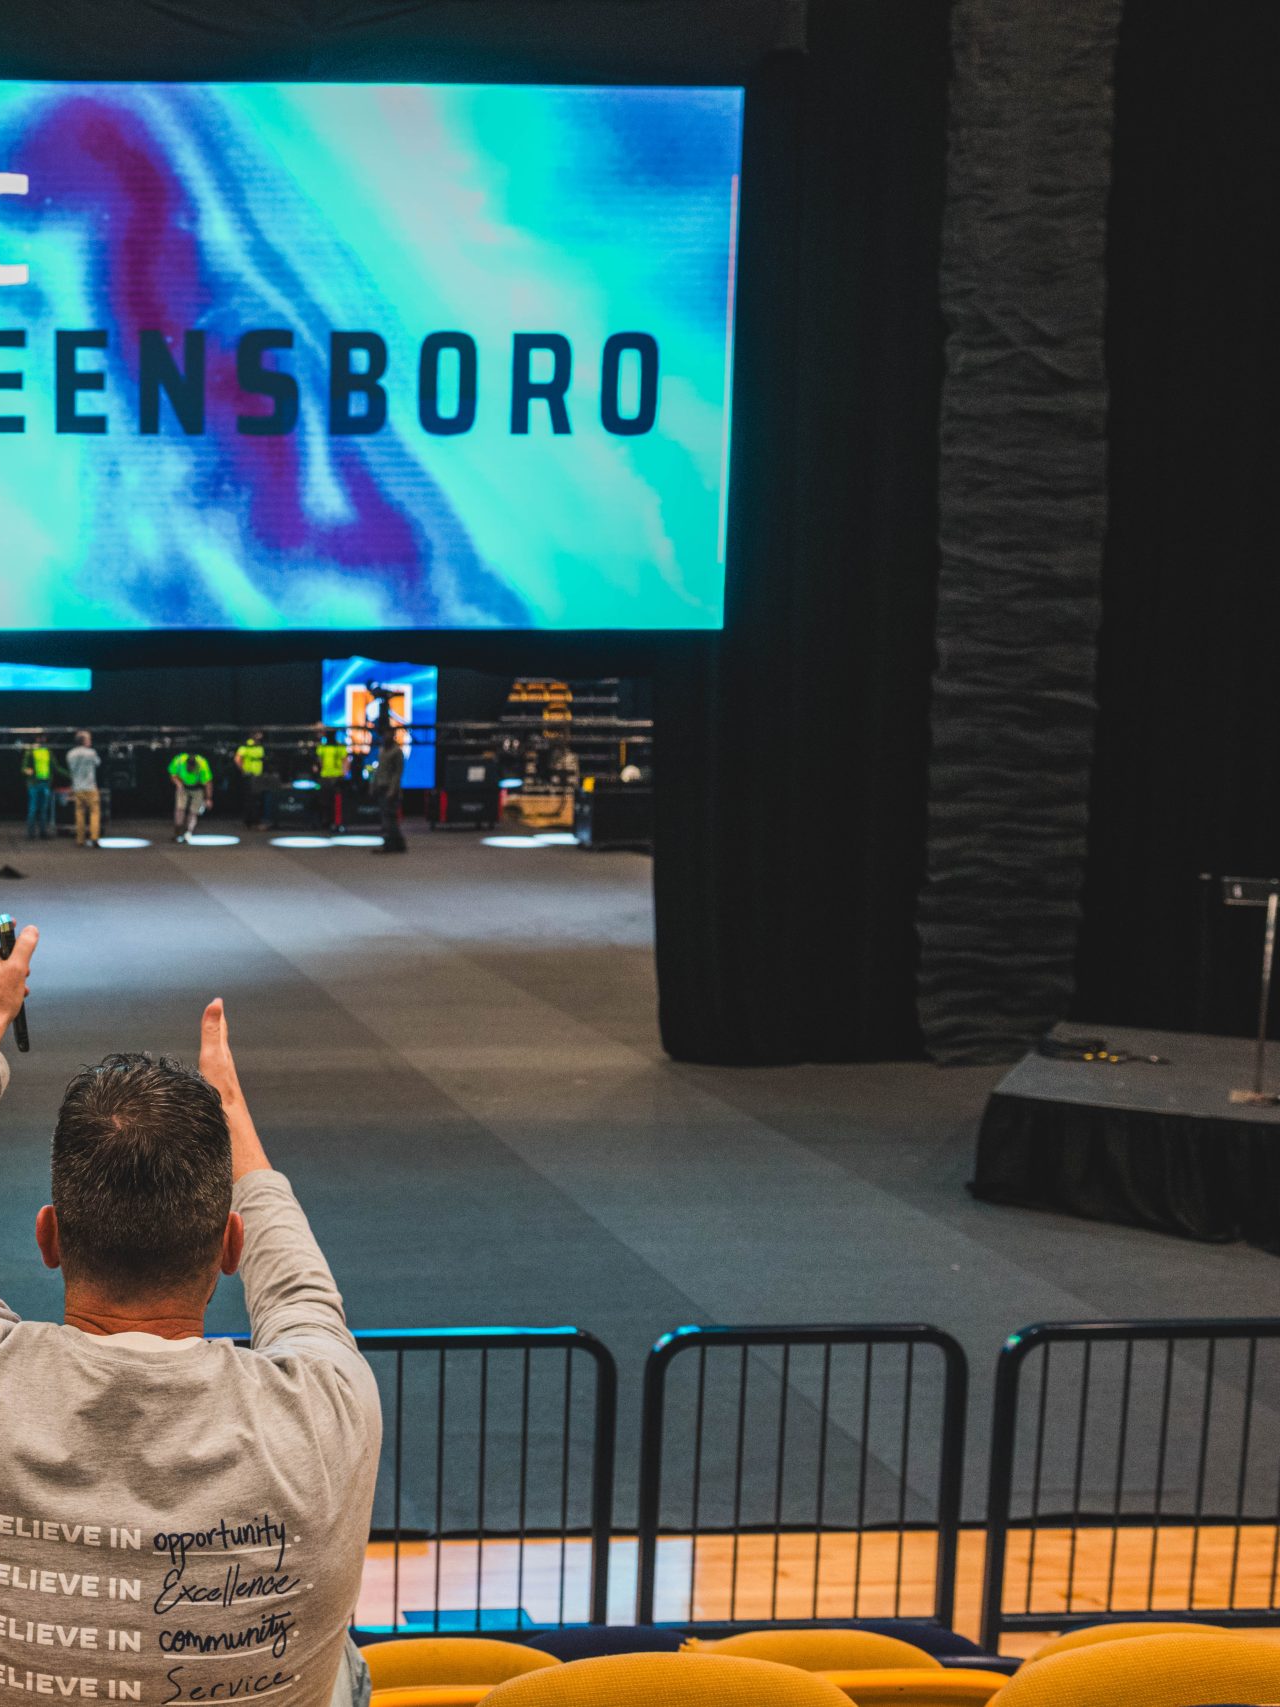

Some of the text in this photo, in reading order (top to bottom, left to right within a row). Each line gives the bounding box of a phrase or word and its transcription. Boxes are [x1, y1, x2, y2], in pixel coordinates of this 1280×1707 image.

[110, 1527, 141, 1550] IN
[109, 1577, 141, 1600] IN
[108, 1629, 141, 1652] IN
[108, 1679, 141, 1700] IN
